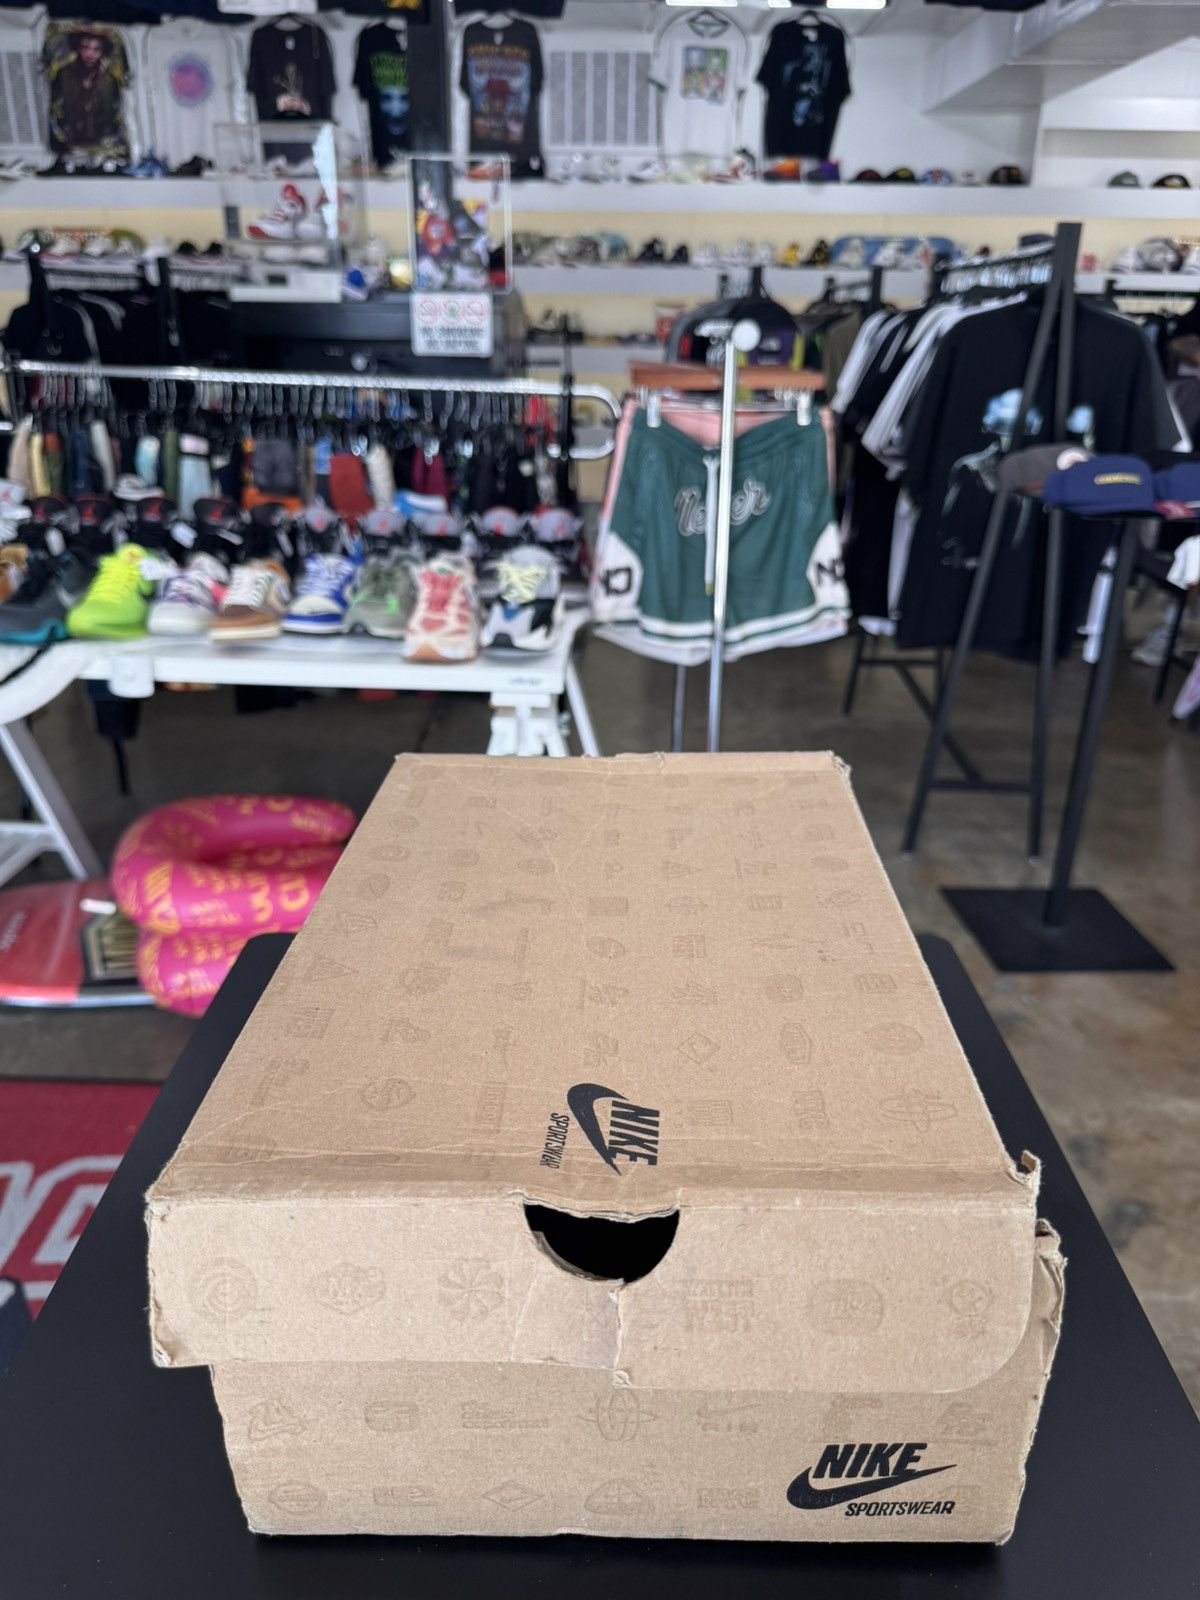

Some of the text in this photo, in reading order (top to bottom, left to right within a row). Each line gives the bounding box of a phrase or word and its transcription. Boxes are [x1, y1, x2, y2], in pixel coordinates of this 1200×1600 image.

[539, 1112, 570, 1169] SPORTSWEAR
[608, 1100, 660, 1166] NIKE
[812, 1443, 928, 1478] NIKE
[845, 1501, 956, 1517] SPORTSWEAR
